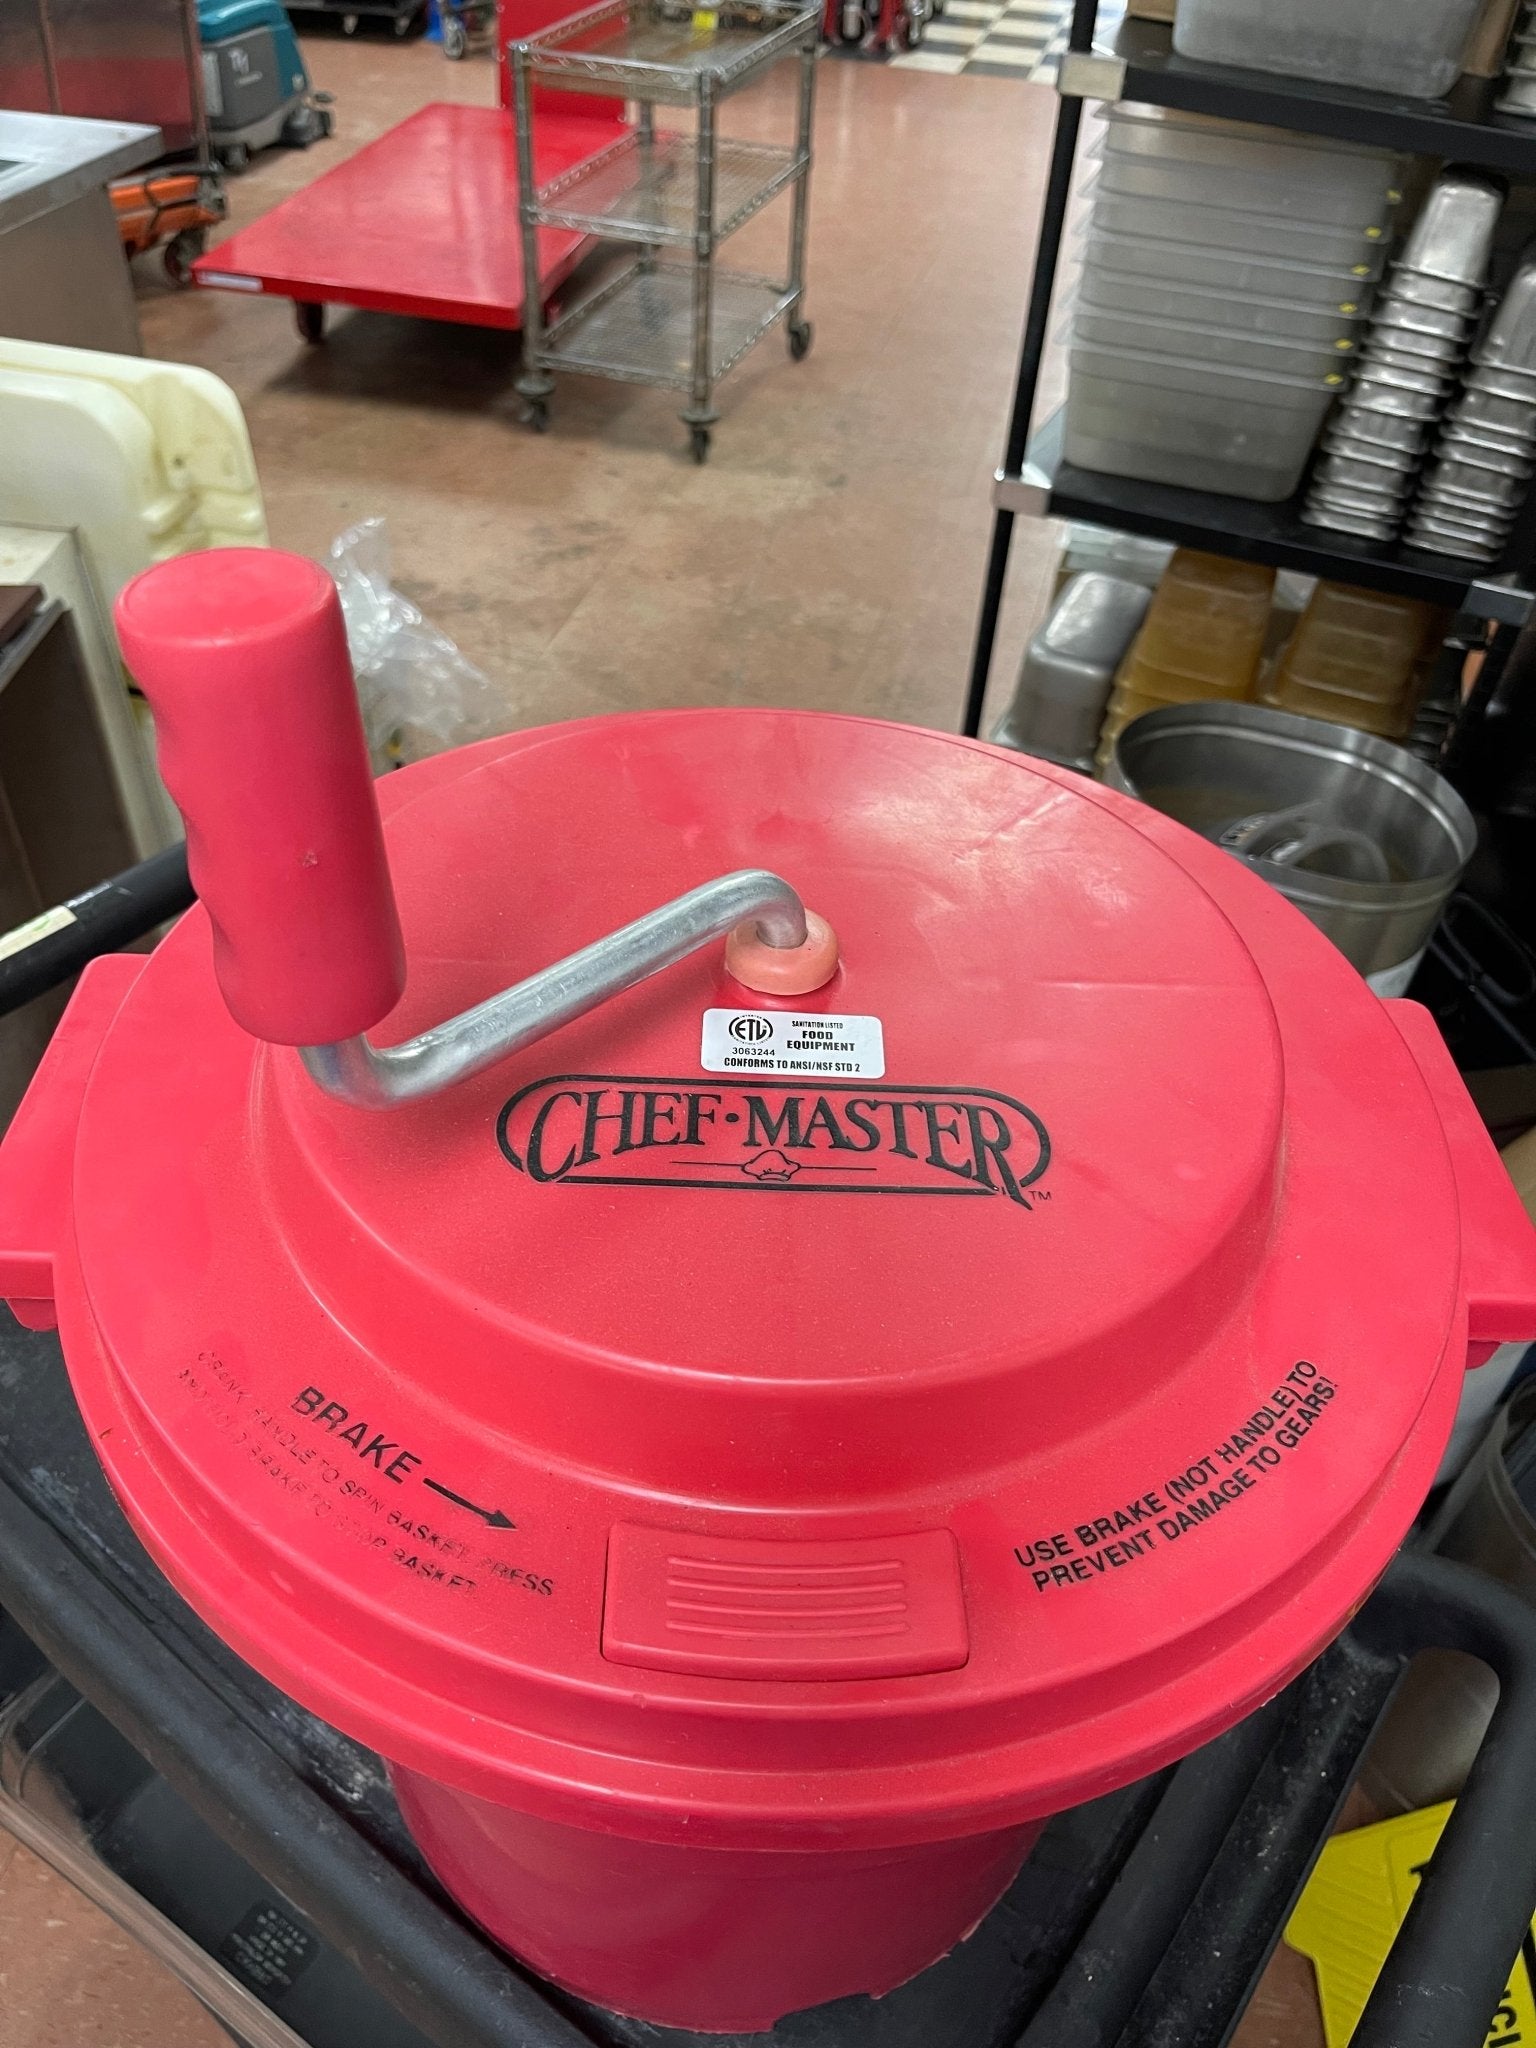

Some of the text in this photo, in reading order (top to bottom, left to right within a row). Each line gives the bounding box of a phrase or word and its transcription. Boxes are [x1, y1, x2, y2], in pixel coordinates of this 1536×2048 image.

[791, 1020, 844, 1030] SANITATION LISTED
[802, 1030, 833, 1040] FOOD
[731, 1047, 775, 1056] 3063244
[786, 1040, 855, 1052] EQUIPMENT
[724, 1057, 861, 1073] CONFORMS TO ANSI/NSF STD 2
[291, 1385, 422, 1484] BRAKE
[1014, 1360, 1317, 1568] USE BRAKE (NOT HANDLE) TO
[1031, 1376, 1339, 1592] PREVENT DAMAGE TO GEARS!
[339, 1480, 385, 1514] SPIN
